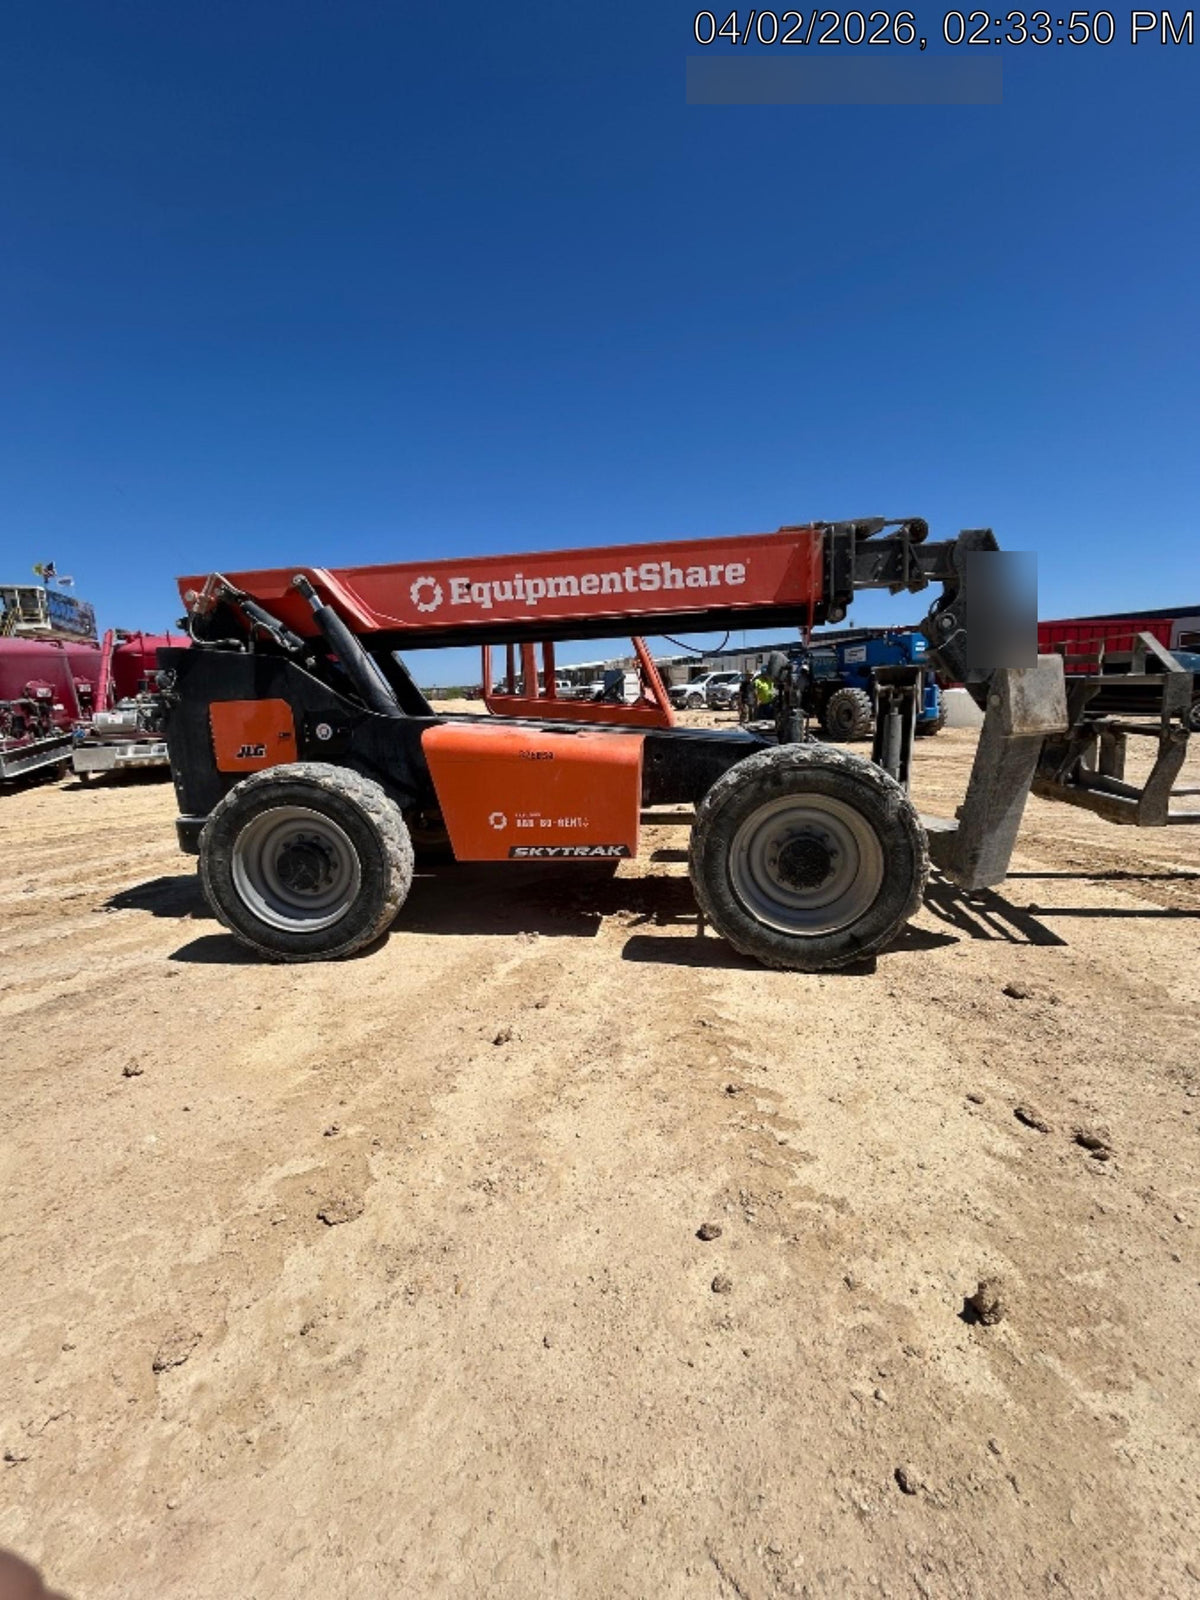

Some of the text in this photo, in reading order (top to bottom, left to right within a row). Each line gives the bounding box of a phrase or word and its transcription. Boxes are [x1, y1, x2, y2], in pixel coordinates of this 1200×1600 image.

[449, 561, 747, 609] EquipmentShare
[235, 744, 267, 758] JLG
[514, 846, 624, 856] SKYTRAK
